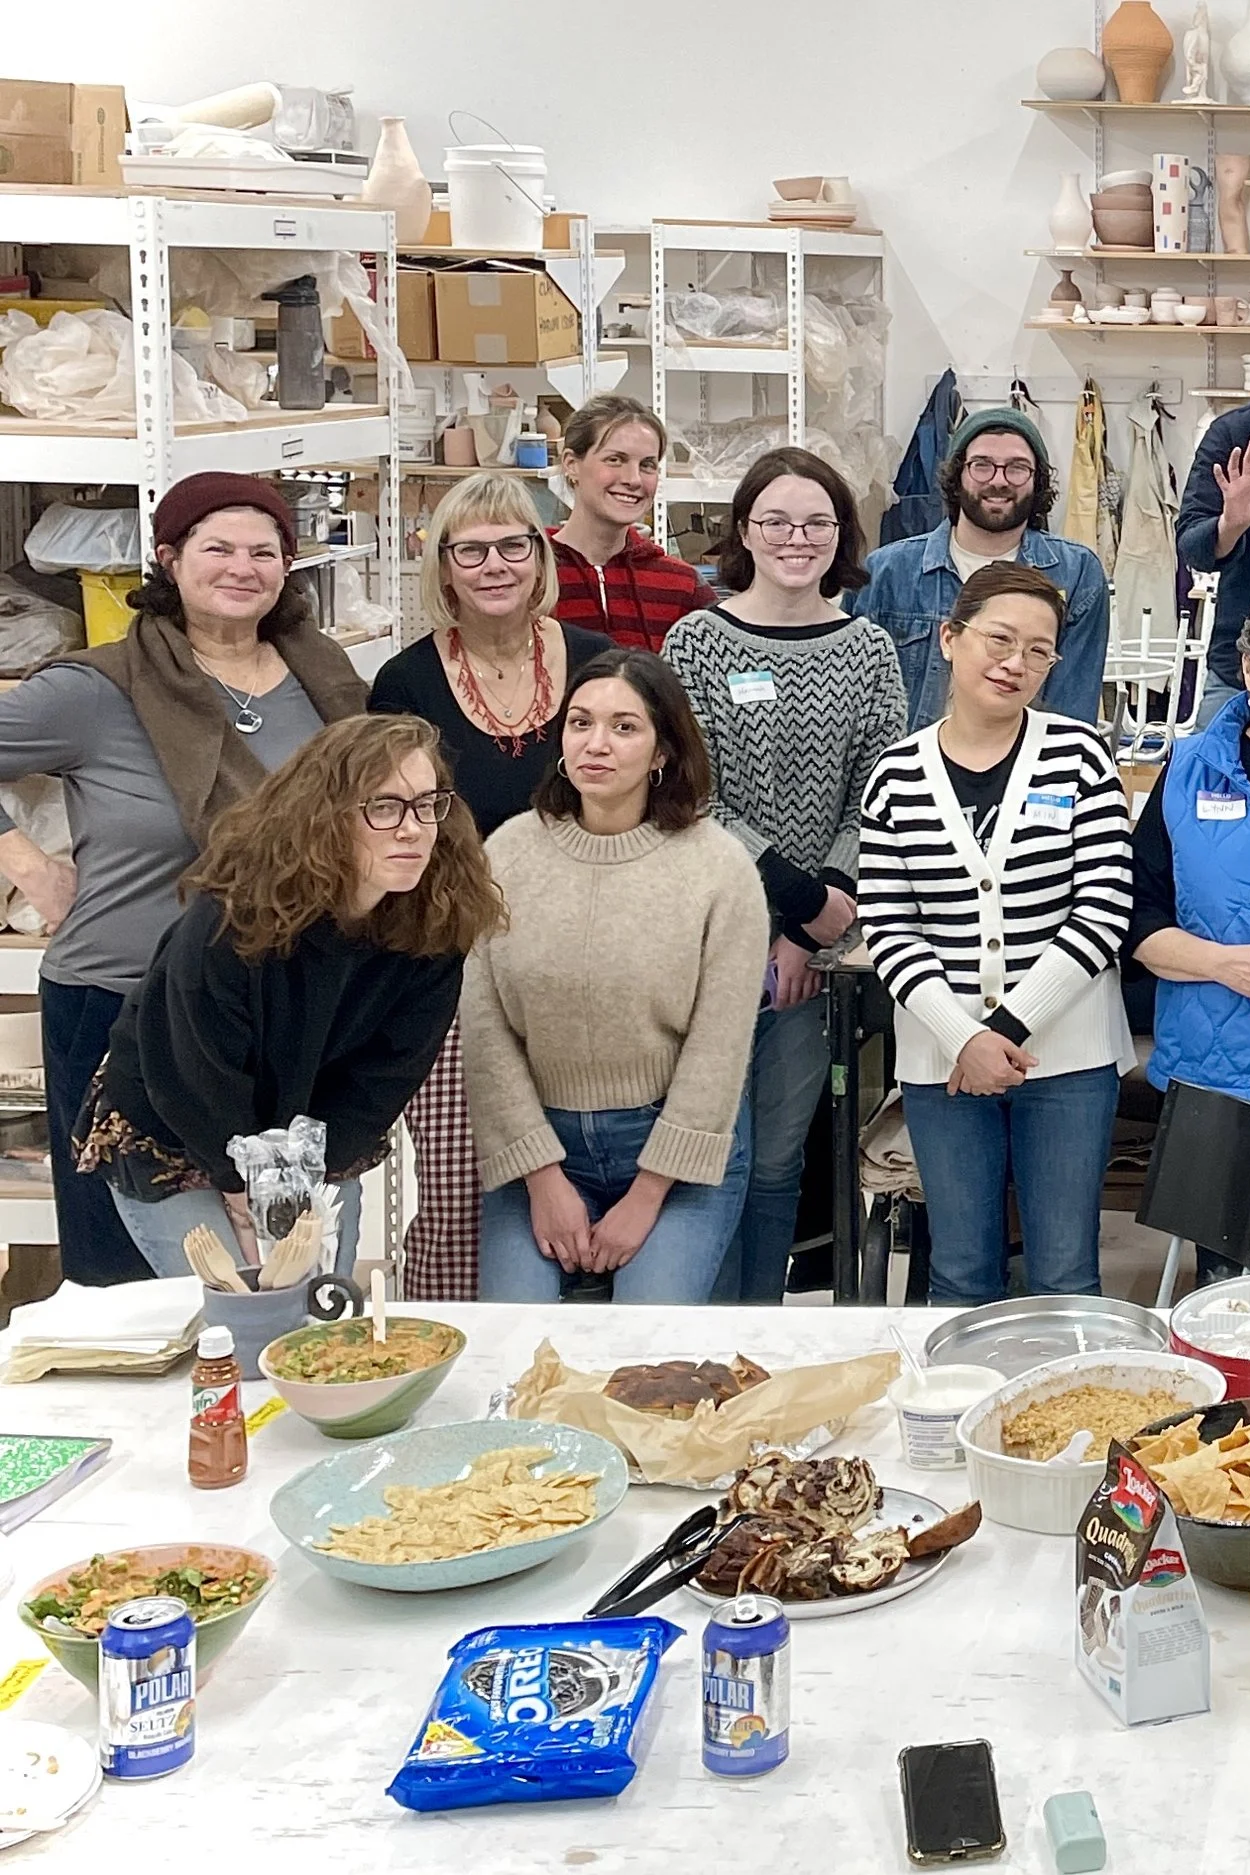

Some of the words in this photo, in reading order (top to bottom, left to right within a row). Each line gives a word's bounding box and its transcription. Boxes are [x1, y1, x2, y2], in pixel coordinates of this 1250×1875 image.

[135, 1671, 190, 1710] POLAR
[507, 1646, 548, 1724] OREO
[704, 1677, 749, 1709] POLAR
